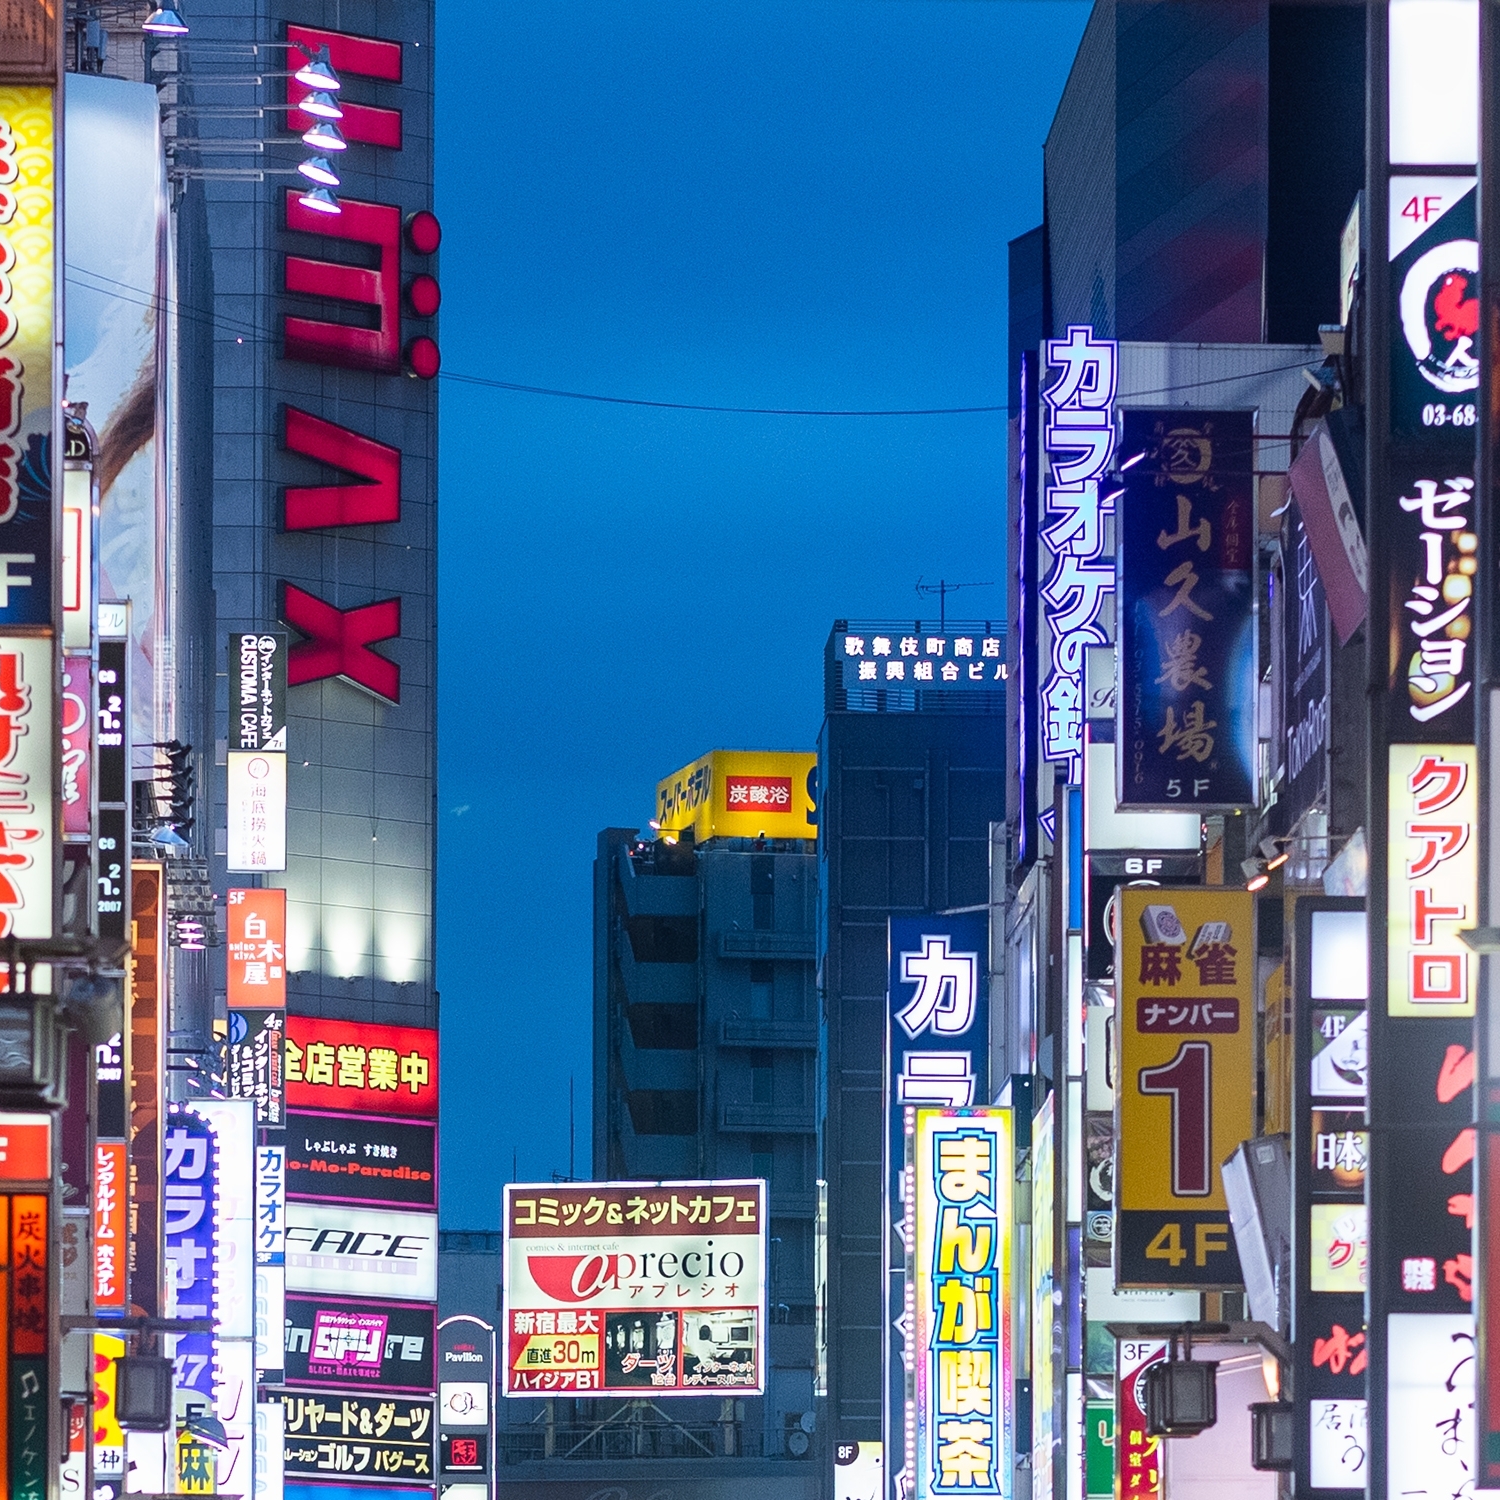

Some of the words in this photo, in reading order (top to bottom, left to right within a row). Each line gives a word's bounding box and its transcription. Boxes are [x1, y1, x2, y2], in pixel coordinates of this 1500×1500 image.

[1401, 196, 1441, 222] 4F
[1399, 475, 1475, 723] ゼーション
[844, 636, 1001, 657] 歌舞伎町商店
[1153, 494, 1218, 764] 山久農場
[240, 634, 258, 705] CUSTOMA
[857, 660, 1009, 682] 振興組合ビル
[260, 653, 273, 740] インターネットカフェ
[240, 711, 258, 749] CAFE
[728, 783, 790, 805] 炭酸浴
[1166, 779, 1211, 798] 5F
[1124, 857, 1163, 875] 6F
[1406, 755, 1469, 1004] クアトロ
[229, 891, 246, 905] 5F
[242, 911, 284, 985] 白木屋
[1138, 942, 1238, 987] 麻雀
[1144, 1003, 1236, 1026] ナンバー
[254, 1030, 269, 1122] インターネット
[285, 1038, 429, 1094] 全店営業中
[1138, 1038, 1213, 1198] 1
[304, 1138, 357, 1155] しゃぶしゃぶ
[363, 1143, 398, 1160] すき焼き
[1315, 1132, 1366, 1172] 日本
[285, 1159, 431, 1181] o-Mo-Paradise
[96, 1147, 116, 1239] レンタルルーム
[259, 1149, 282, 1249] カラオケ
[514, 1194, 757, 1227] コミック&ネットカフェ
[1144, 1222, 1229, 1267] 4F
[14, 1210, 45, 1336] 炭火串焼
[96, 1244, 116, 1297] ホステル
[570, 1239, 745, 1298] aprecio
[628, 1282, 740, 1299] アプレシオ
[514, 1310, 600, 1336] 新宿最大
[929, 1127, 1000, 1495] まんが喫茶
[444, 1351, 484, 1364] Pavilion
[526, 1340, 596, 1364] 直進30m
[621, 1352, 676, 1374] ダーツ
[1123, 1343, 1151, 1361] 3F
[512, 1369, 600, 1390] ハイジアB1
[285, 1395, 431, 1440] リヤード&ダーツ
[318, 1443, 372, 1473] ゴルフ
[373, 1450, 430, 1475] バグース
